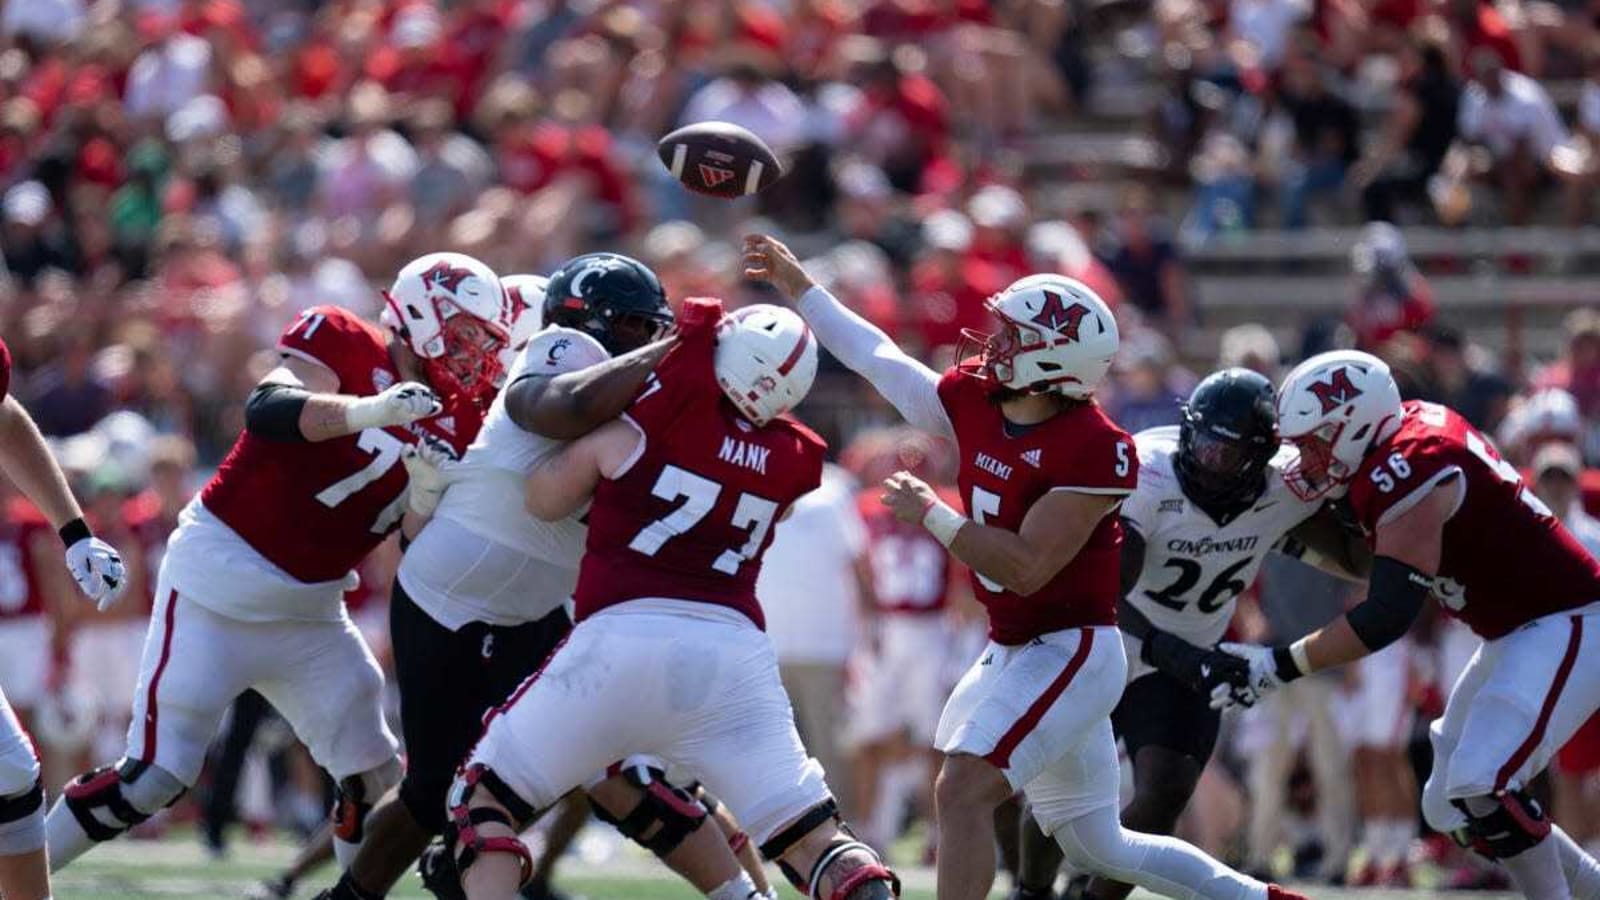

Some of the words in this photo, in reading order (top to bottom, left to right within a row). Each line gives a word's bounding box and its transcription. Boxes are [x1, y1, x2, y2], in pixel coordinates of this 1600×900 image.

[1031, 290, 1091, 342] M
[1306, 366, 1363, 414] M
[718, 435, 770, 476] NANK
[975, 452, 1013, 480] MIAMI
[1115, 442, 1129, 477] 5
[1370, 453, 1411, 493] 56
[628, 463, 779, 576] 77
[1167, 536, 1259, 557] CINCINNATI
[1144, 557, 1252, 614] 26
